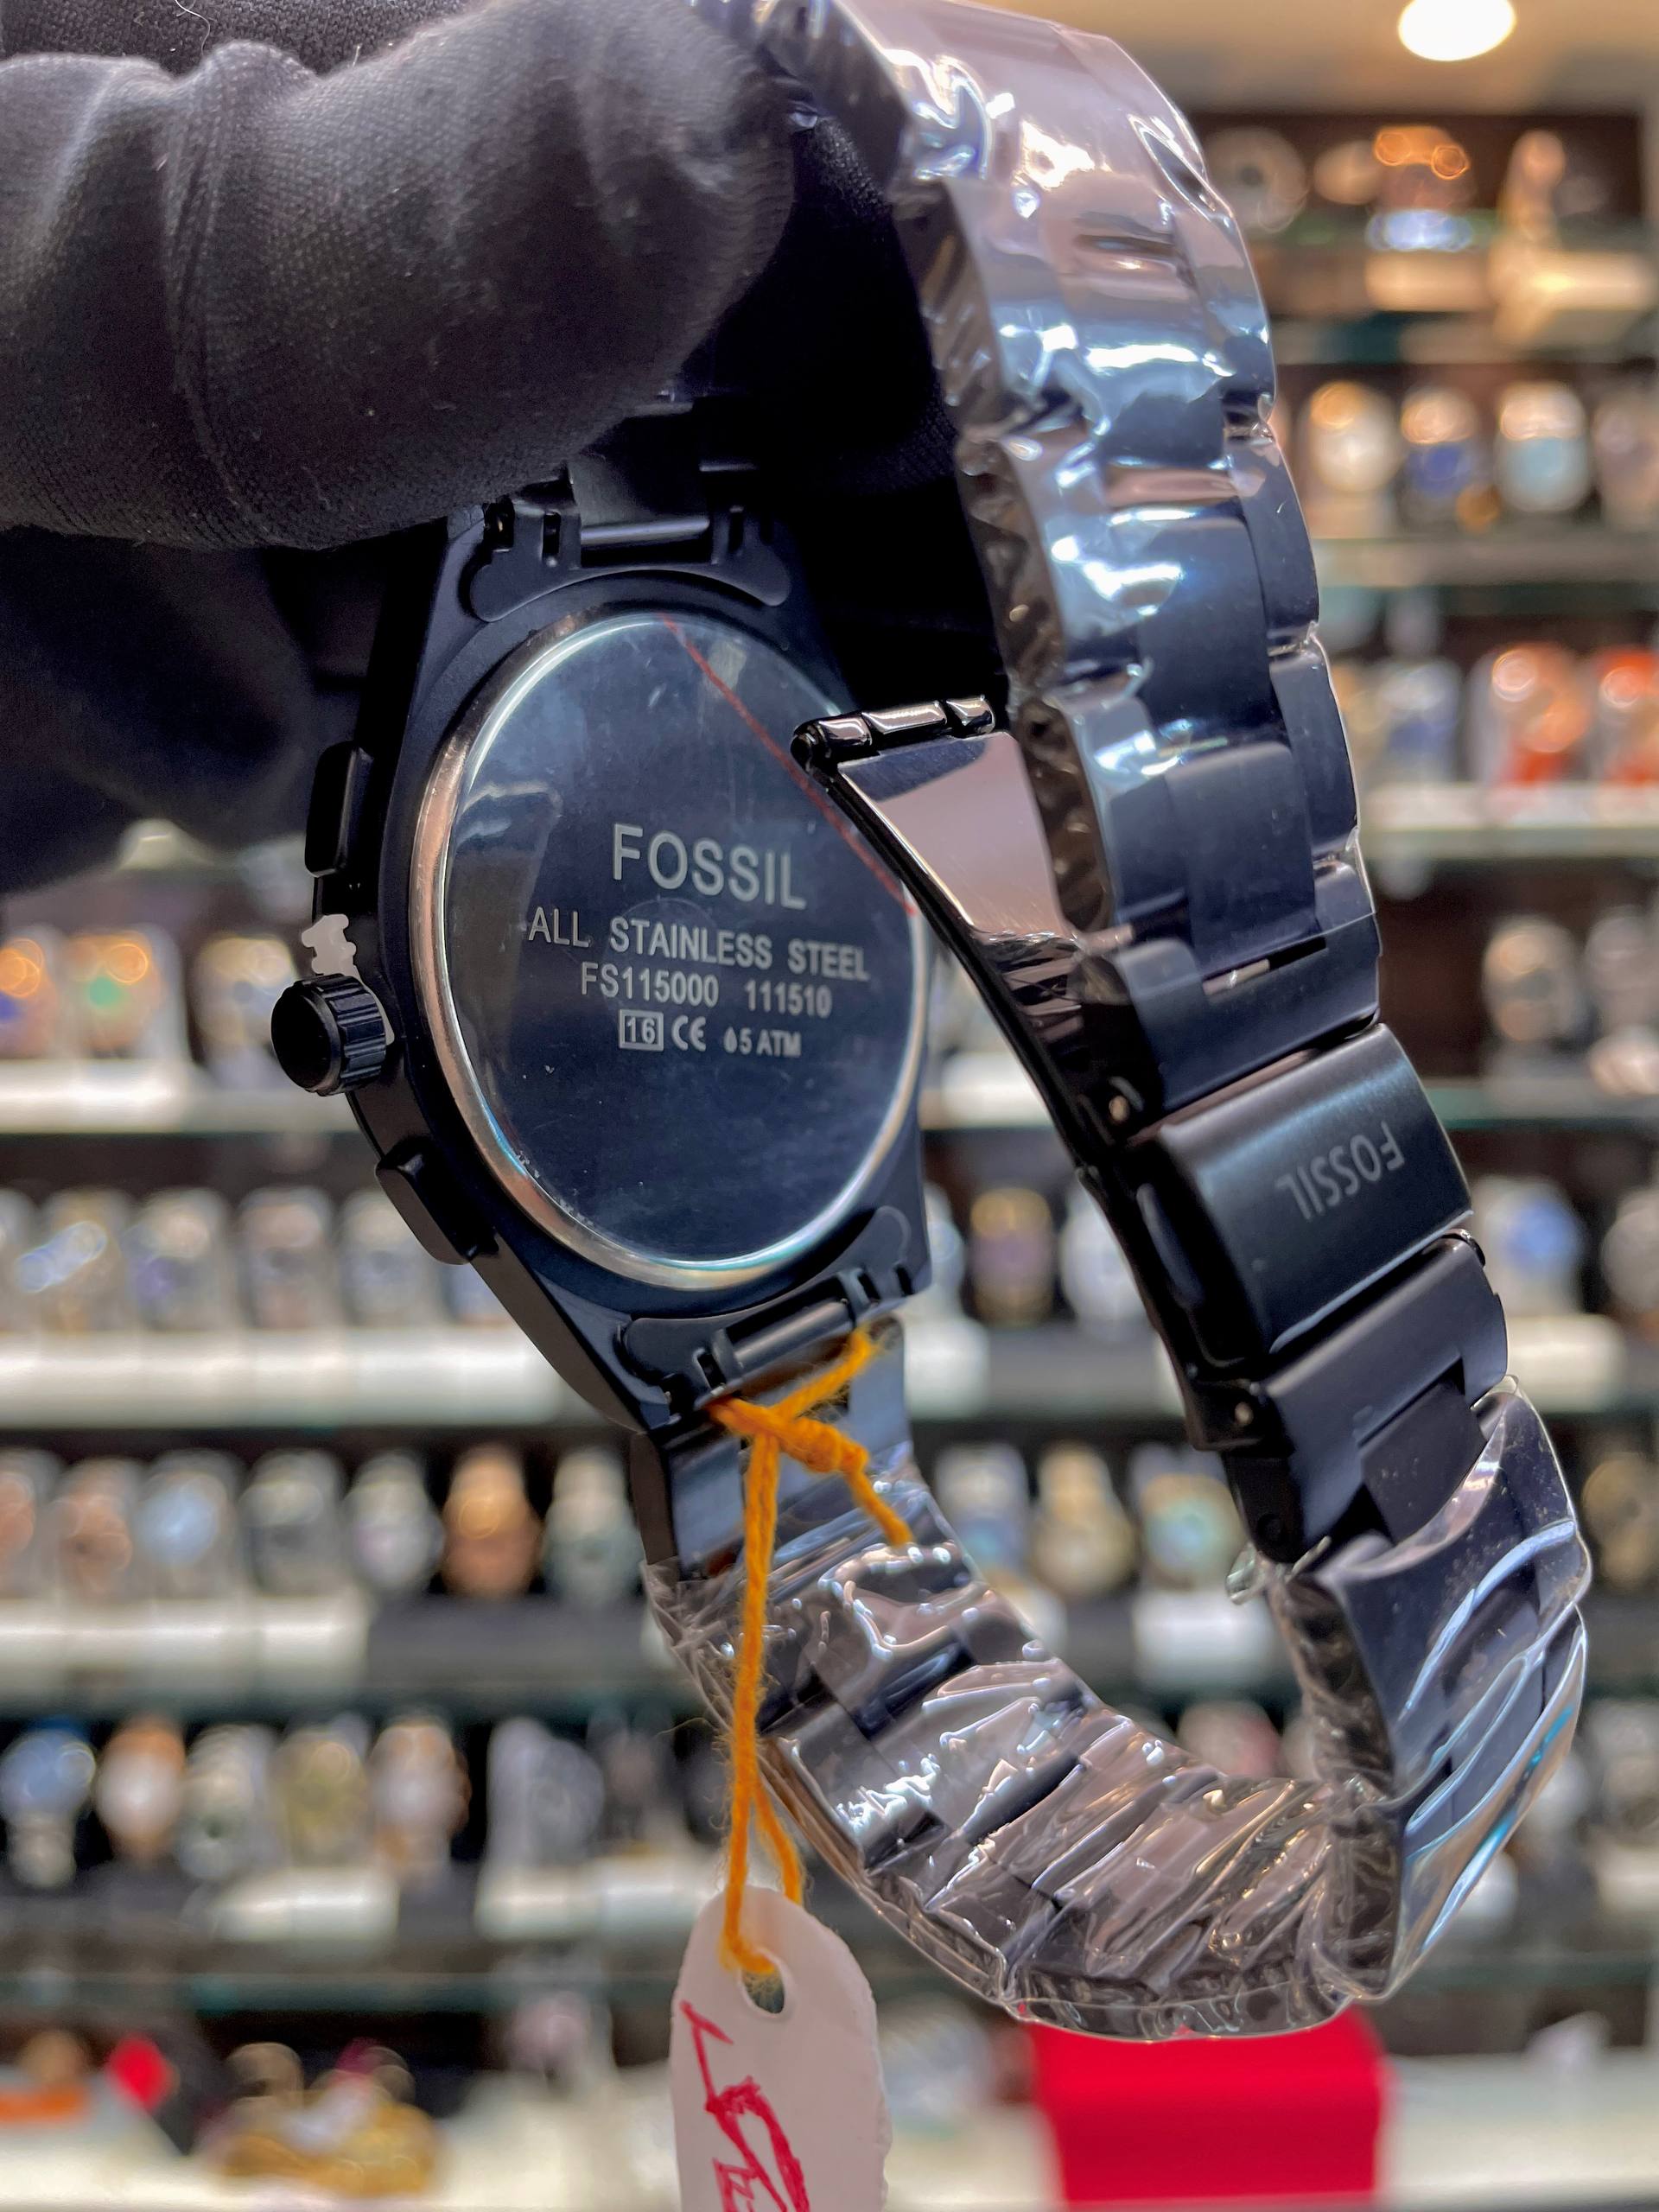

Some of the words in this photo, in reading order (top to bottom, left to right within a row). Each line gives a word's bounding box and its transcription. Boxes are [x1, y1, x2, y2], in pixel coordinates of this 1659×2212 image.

[613, 823, 807, 909] FOSSIL
[528, 906, 591, 947] ALL
[609, 917, 772, 969] STAINLESS
[787, 938, 870, 980] STEEL
[580, 962, 720, 1007] FS115000
[745, 980, 832, 1019] 111510
[626, 1015, 657, 1045] 16
[1274, 1121, 1406, 1222] FOSSIL
